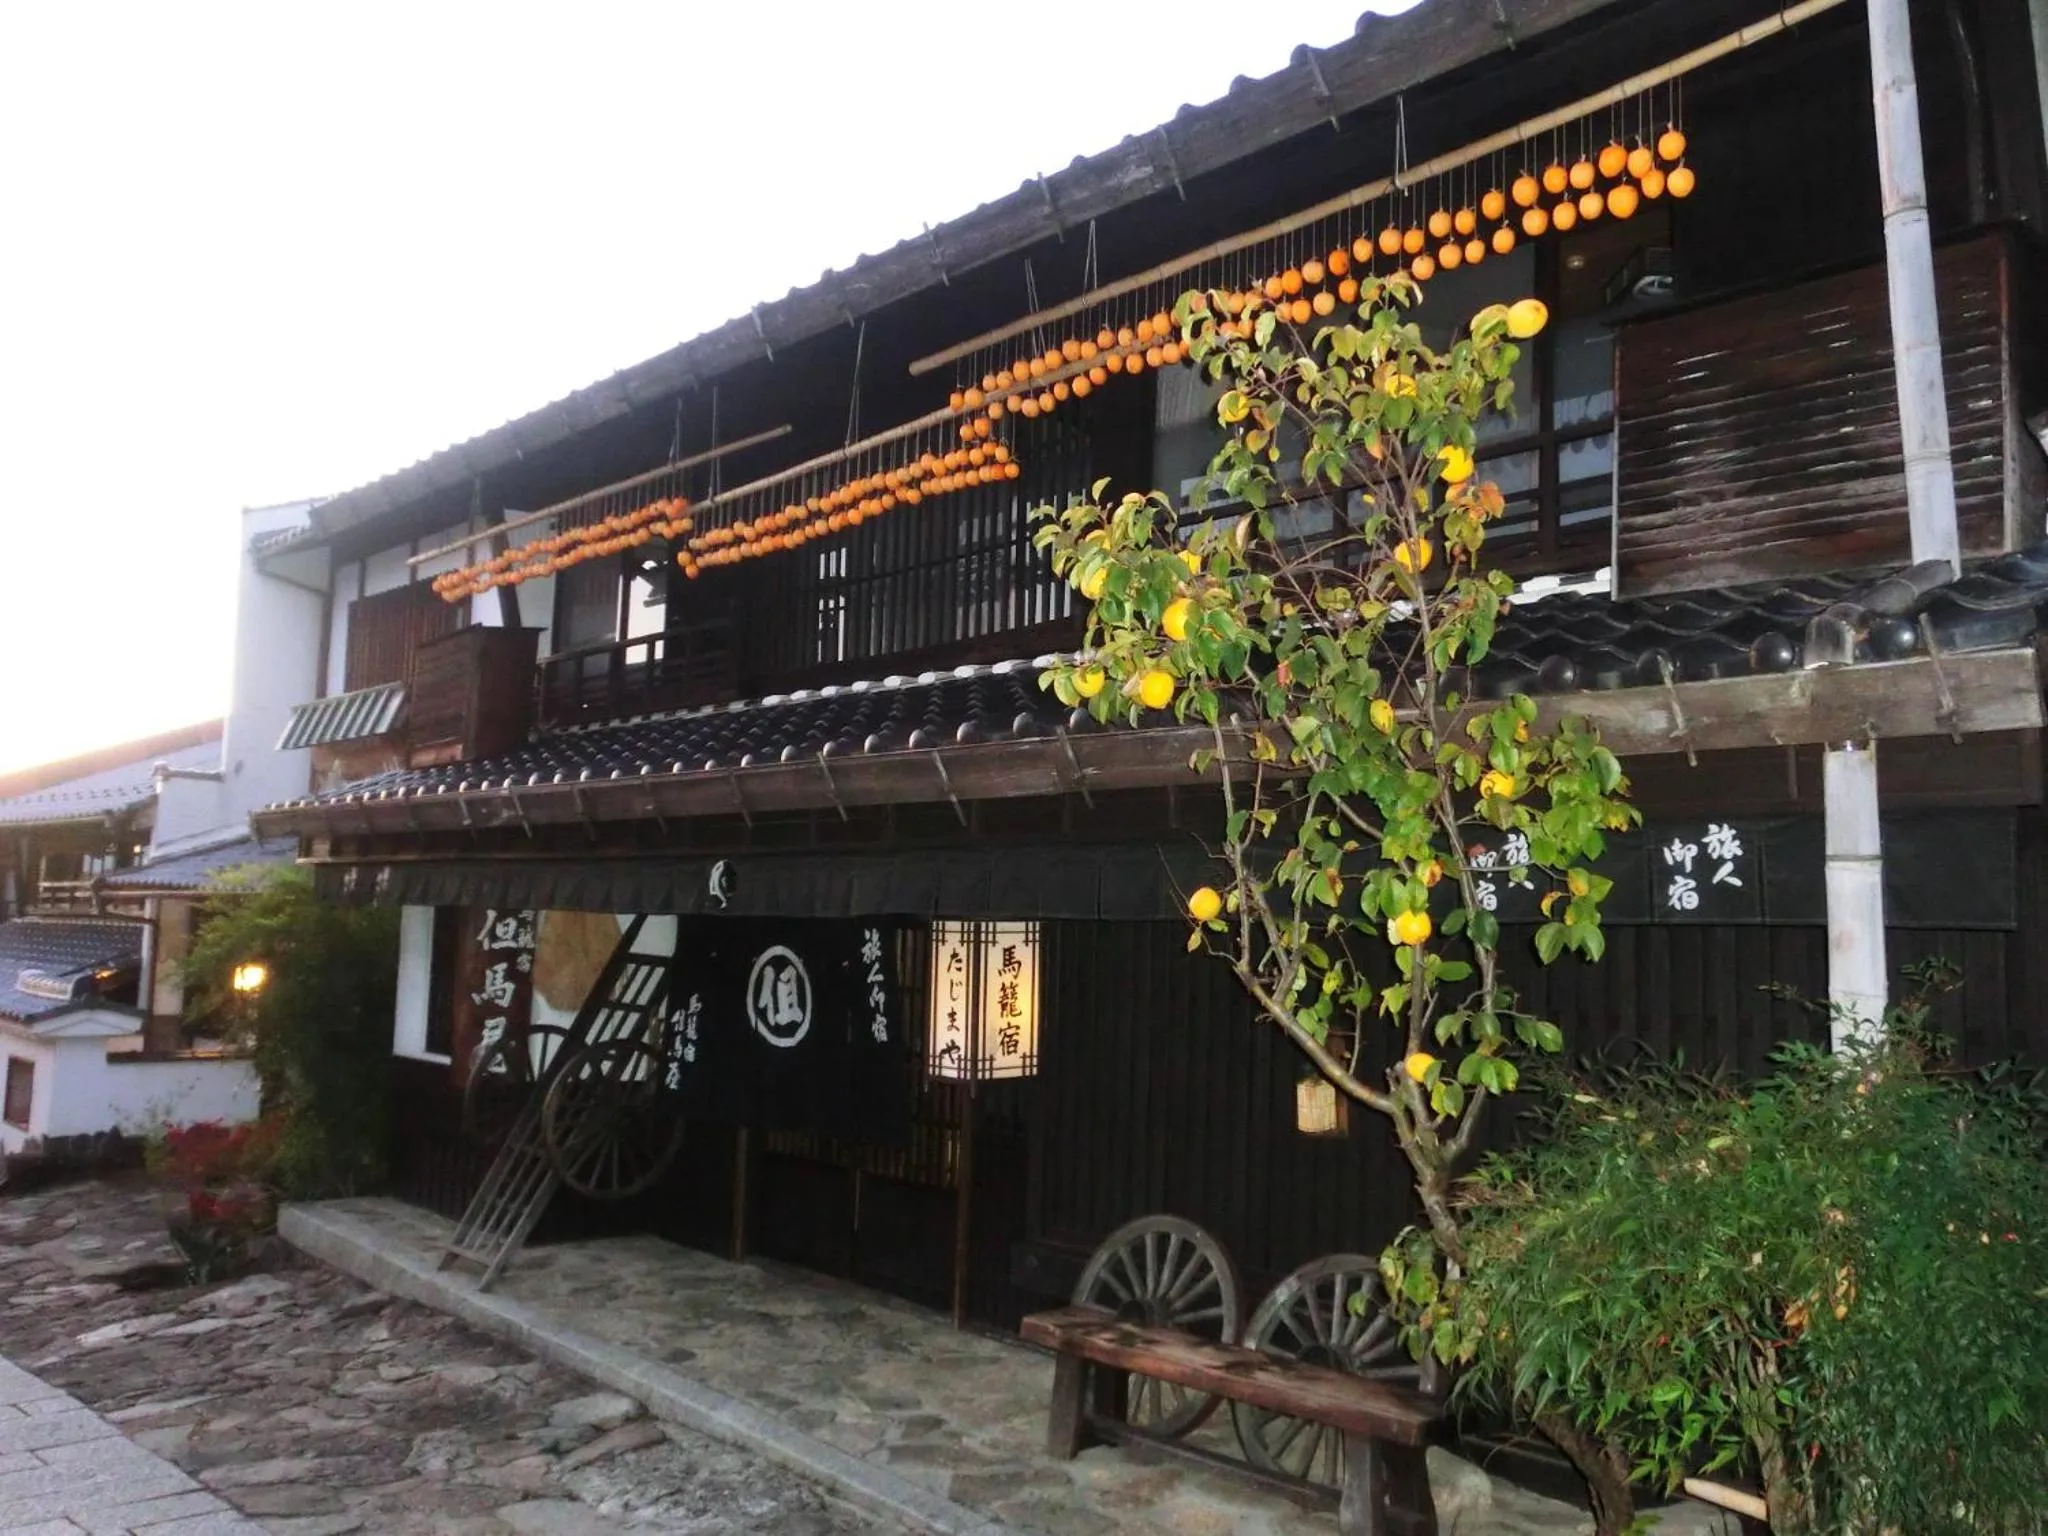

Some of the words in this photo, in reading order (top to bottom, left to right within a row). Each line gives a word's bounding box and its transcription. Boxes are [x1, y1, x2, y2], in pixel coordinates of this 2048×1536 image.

[1662, 837, 1700, 911] 御宿
[1701, 823, 1744, 887] 旅人
[938, 947, 963, 1066] たじまや
[997, 944, 1023, 1057] 馬籠宿
